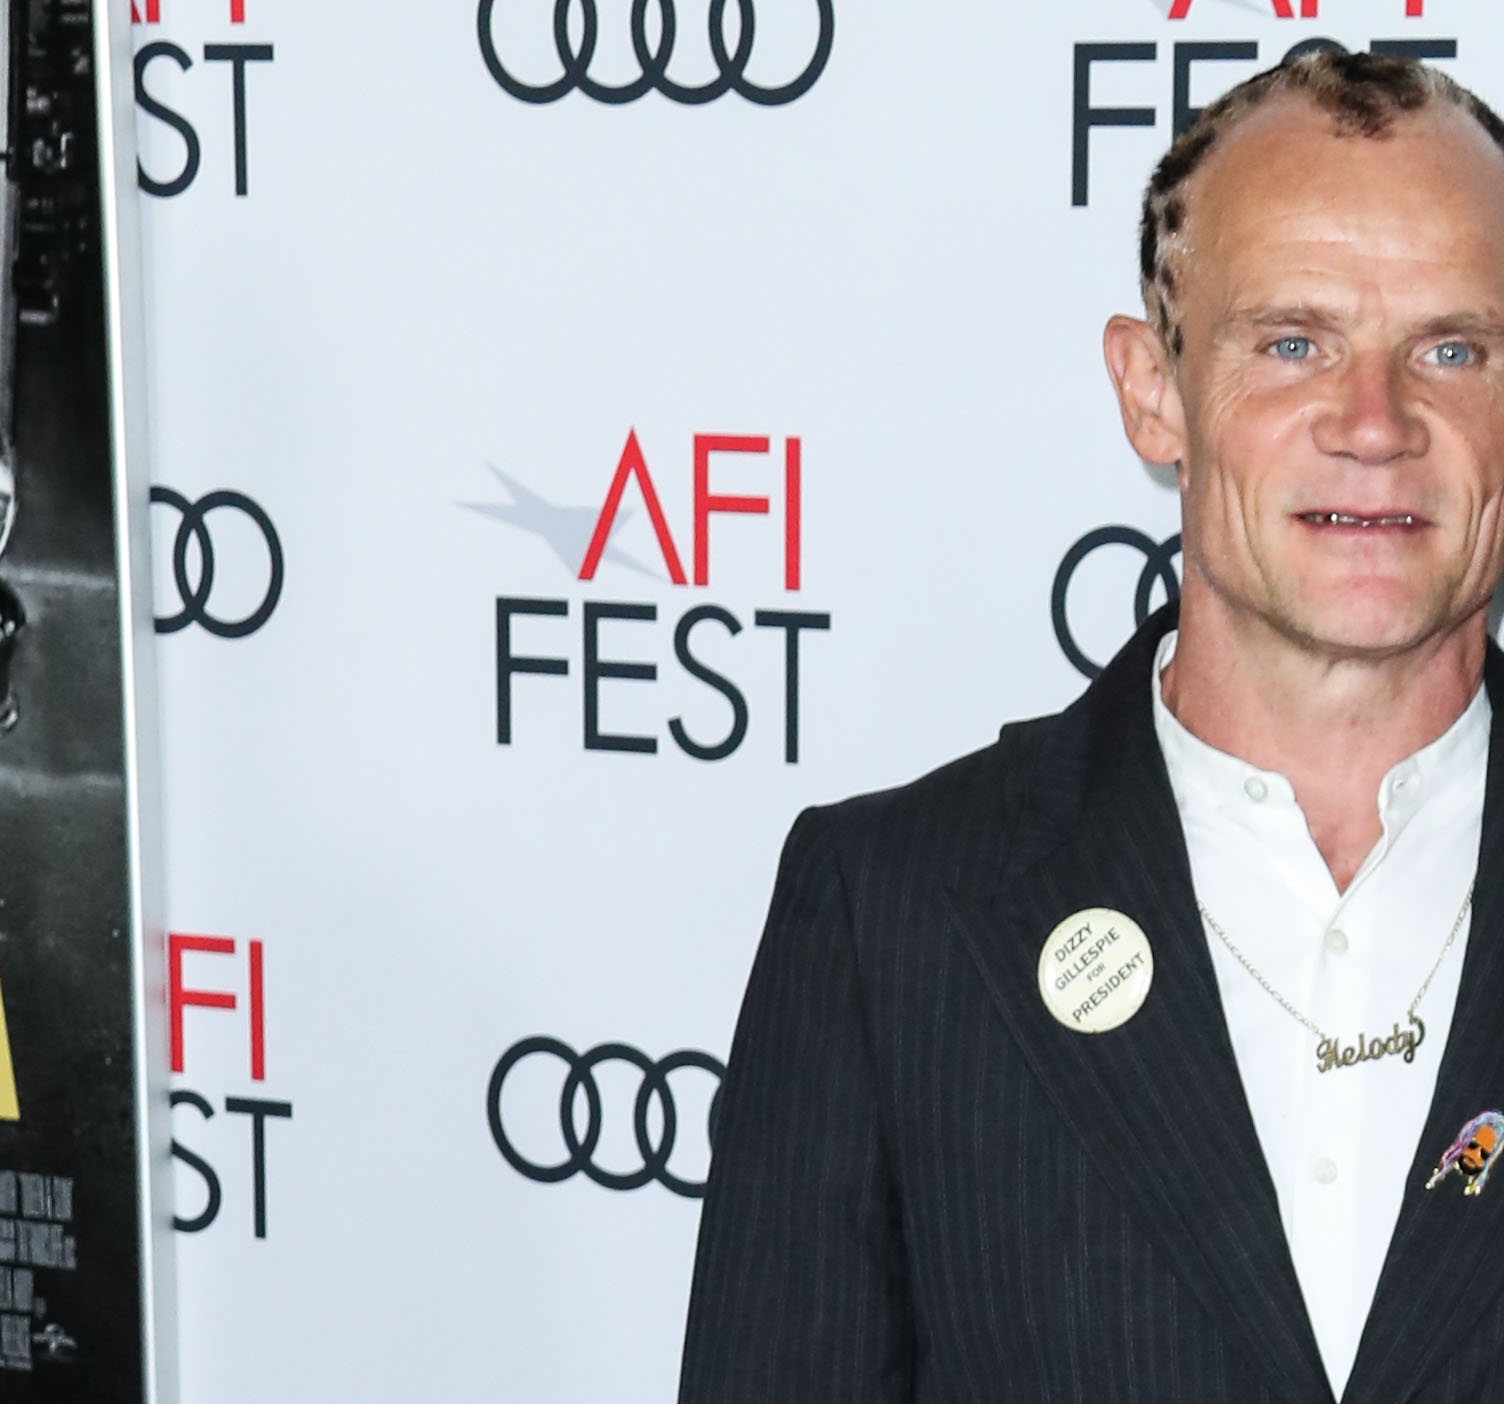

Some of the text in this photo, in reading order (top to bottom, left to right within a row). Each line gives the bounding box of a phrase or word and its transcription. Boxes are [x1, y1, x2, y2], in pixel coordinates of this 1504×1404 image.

[134, 41, 275, 197] ST
[578, 427, 802, 591] AFI
[496, 596, 831, 764] FEST
[1055, 922, 1093, 962] DIZZY
[1055, 926, 1121, 991] GILLESPIE
[1072, 952, 1145, 1023] PRESIDENT
[1086, 961, 1106, 983] FOR
[167, 932, 266, 1081] FI
[1316, 1016, 1426, 1074] Melody
[170, 1090, 294, 1239] ST
